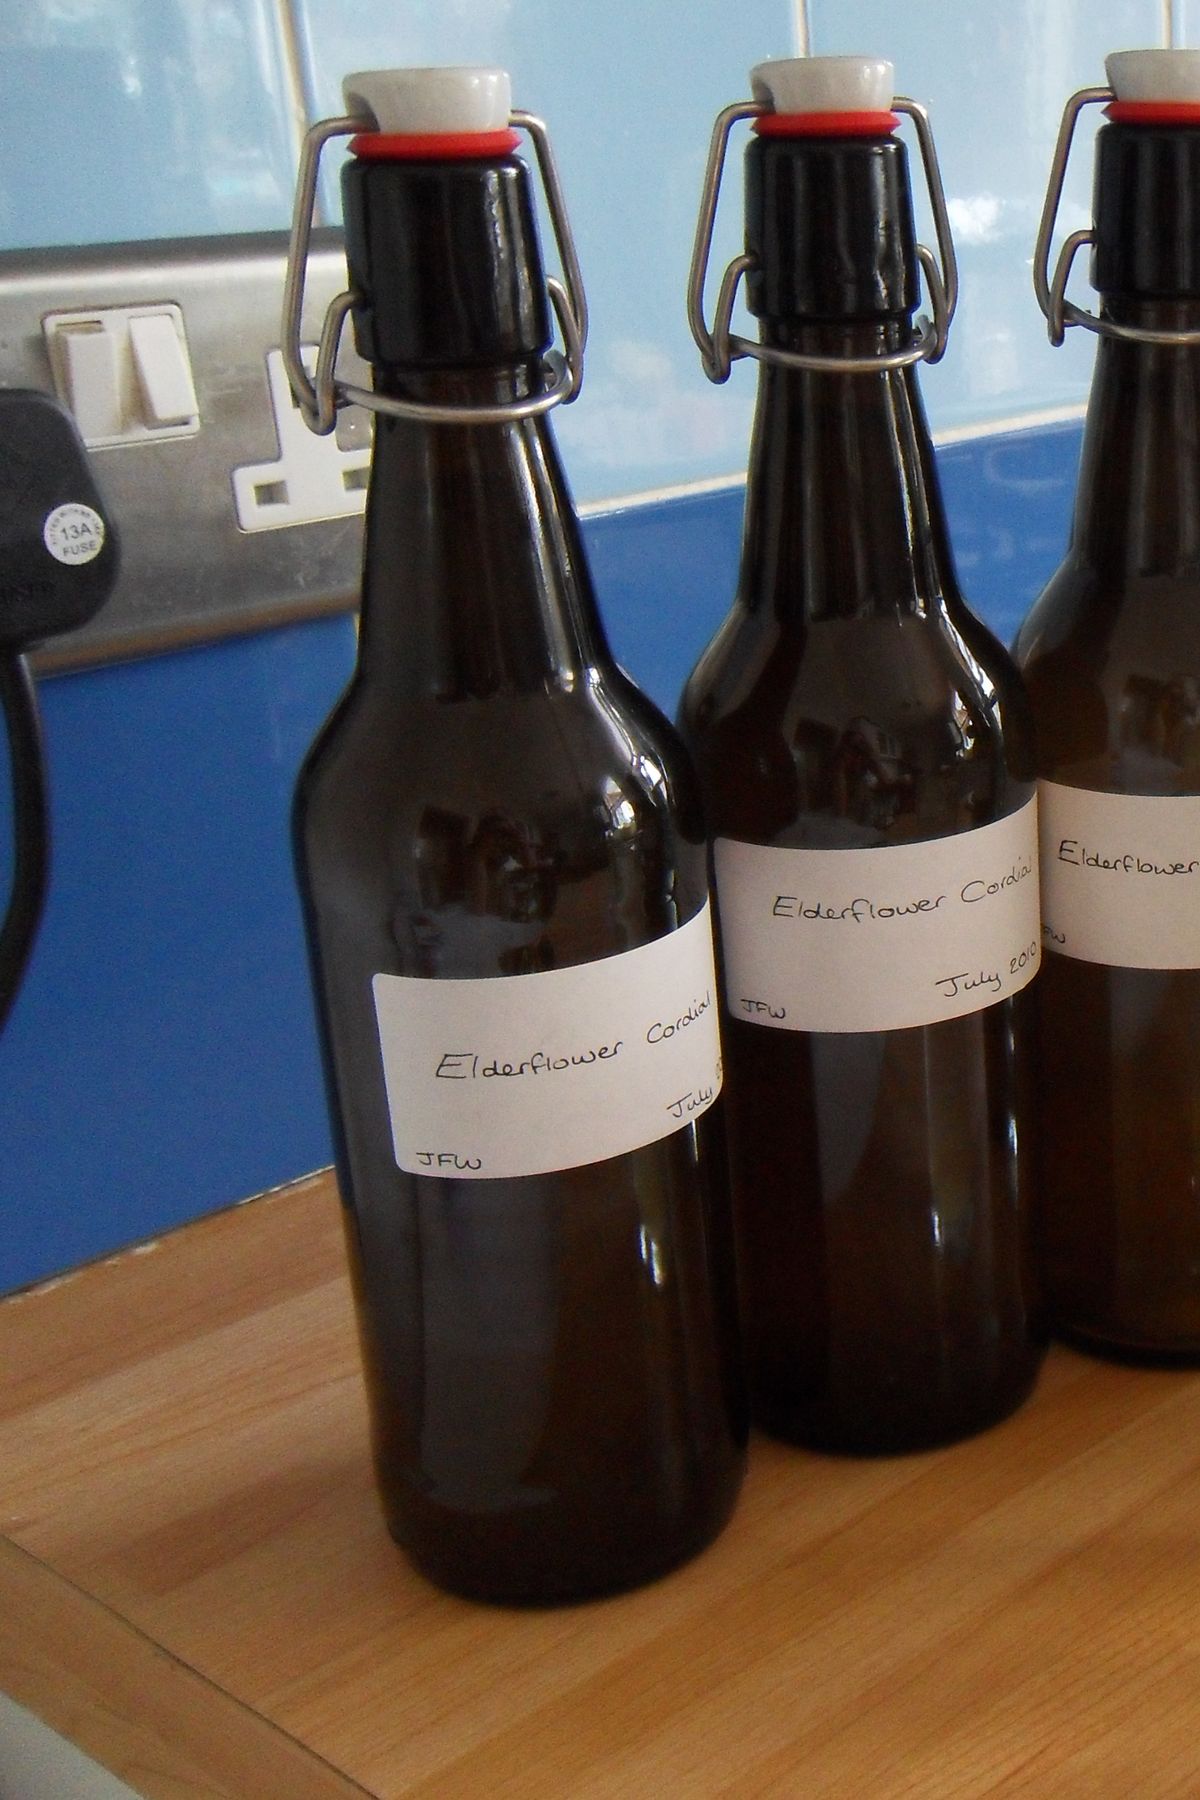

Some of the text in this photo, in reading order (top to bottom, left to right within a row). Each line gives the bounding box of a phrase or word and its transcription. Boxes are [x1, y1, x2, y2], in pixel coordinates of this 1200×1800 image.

[61, 522, 93, 541] 13A
[62, 540, 97, 557] FUSE
[1057, 839, 1200, 875] Elderflower
[772, 895, 948, 923] Elderflower
[935, 941, 1038, 998] July 2010
[740, 998, 786, 1020] JFW
[435, 990, 712, 1080] Elderflower Cordial
[666, 1086, 714, 1119] July
[415, 1151, 483, 1171] JFW
